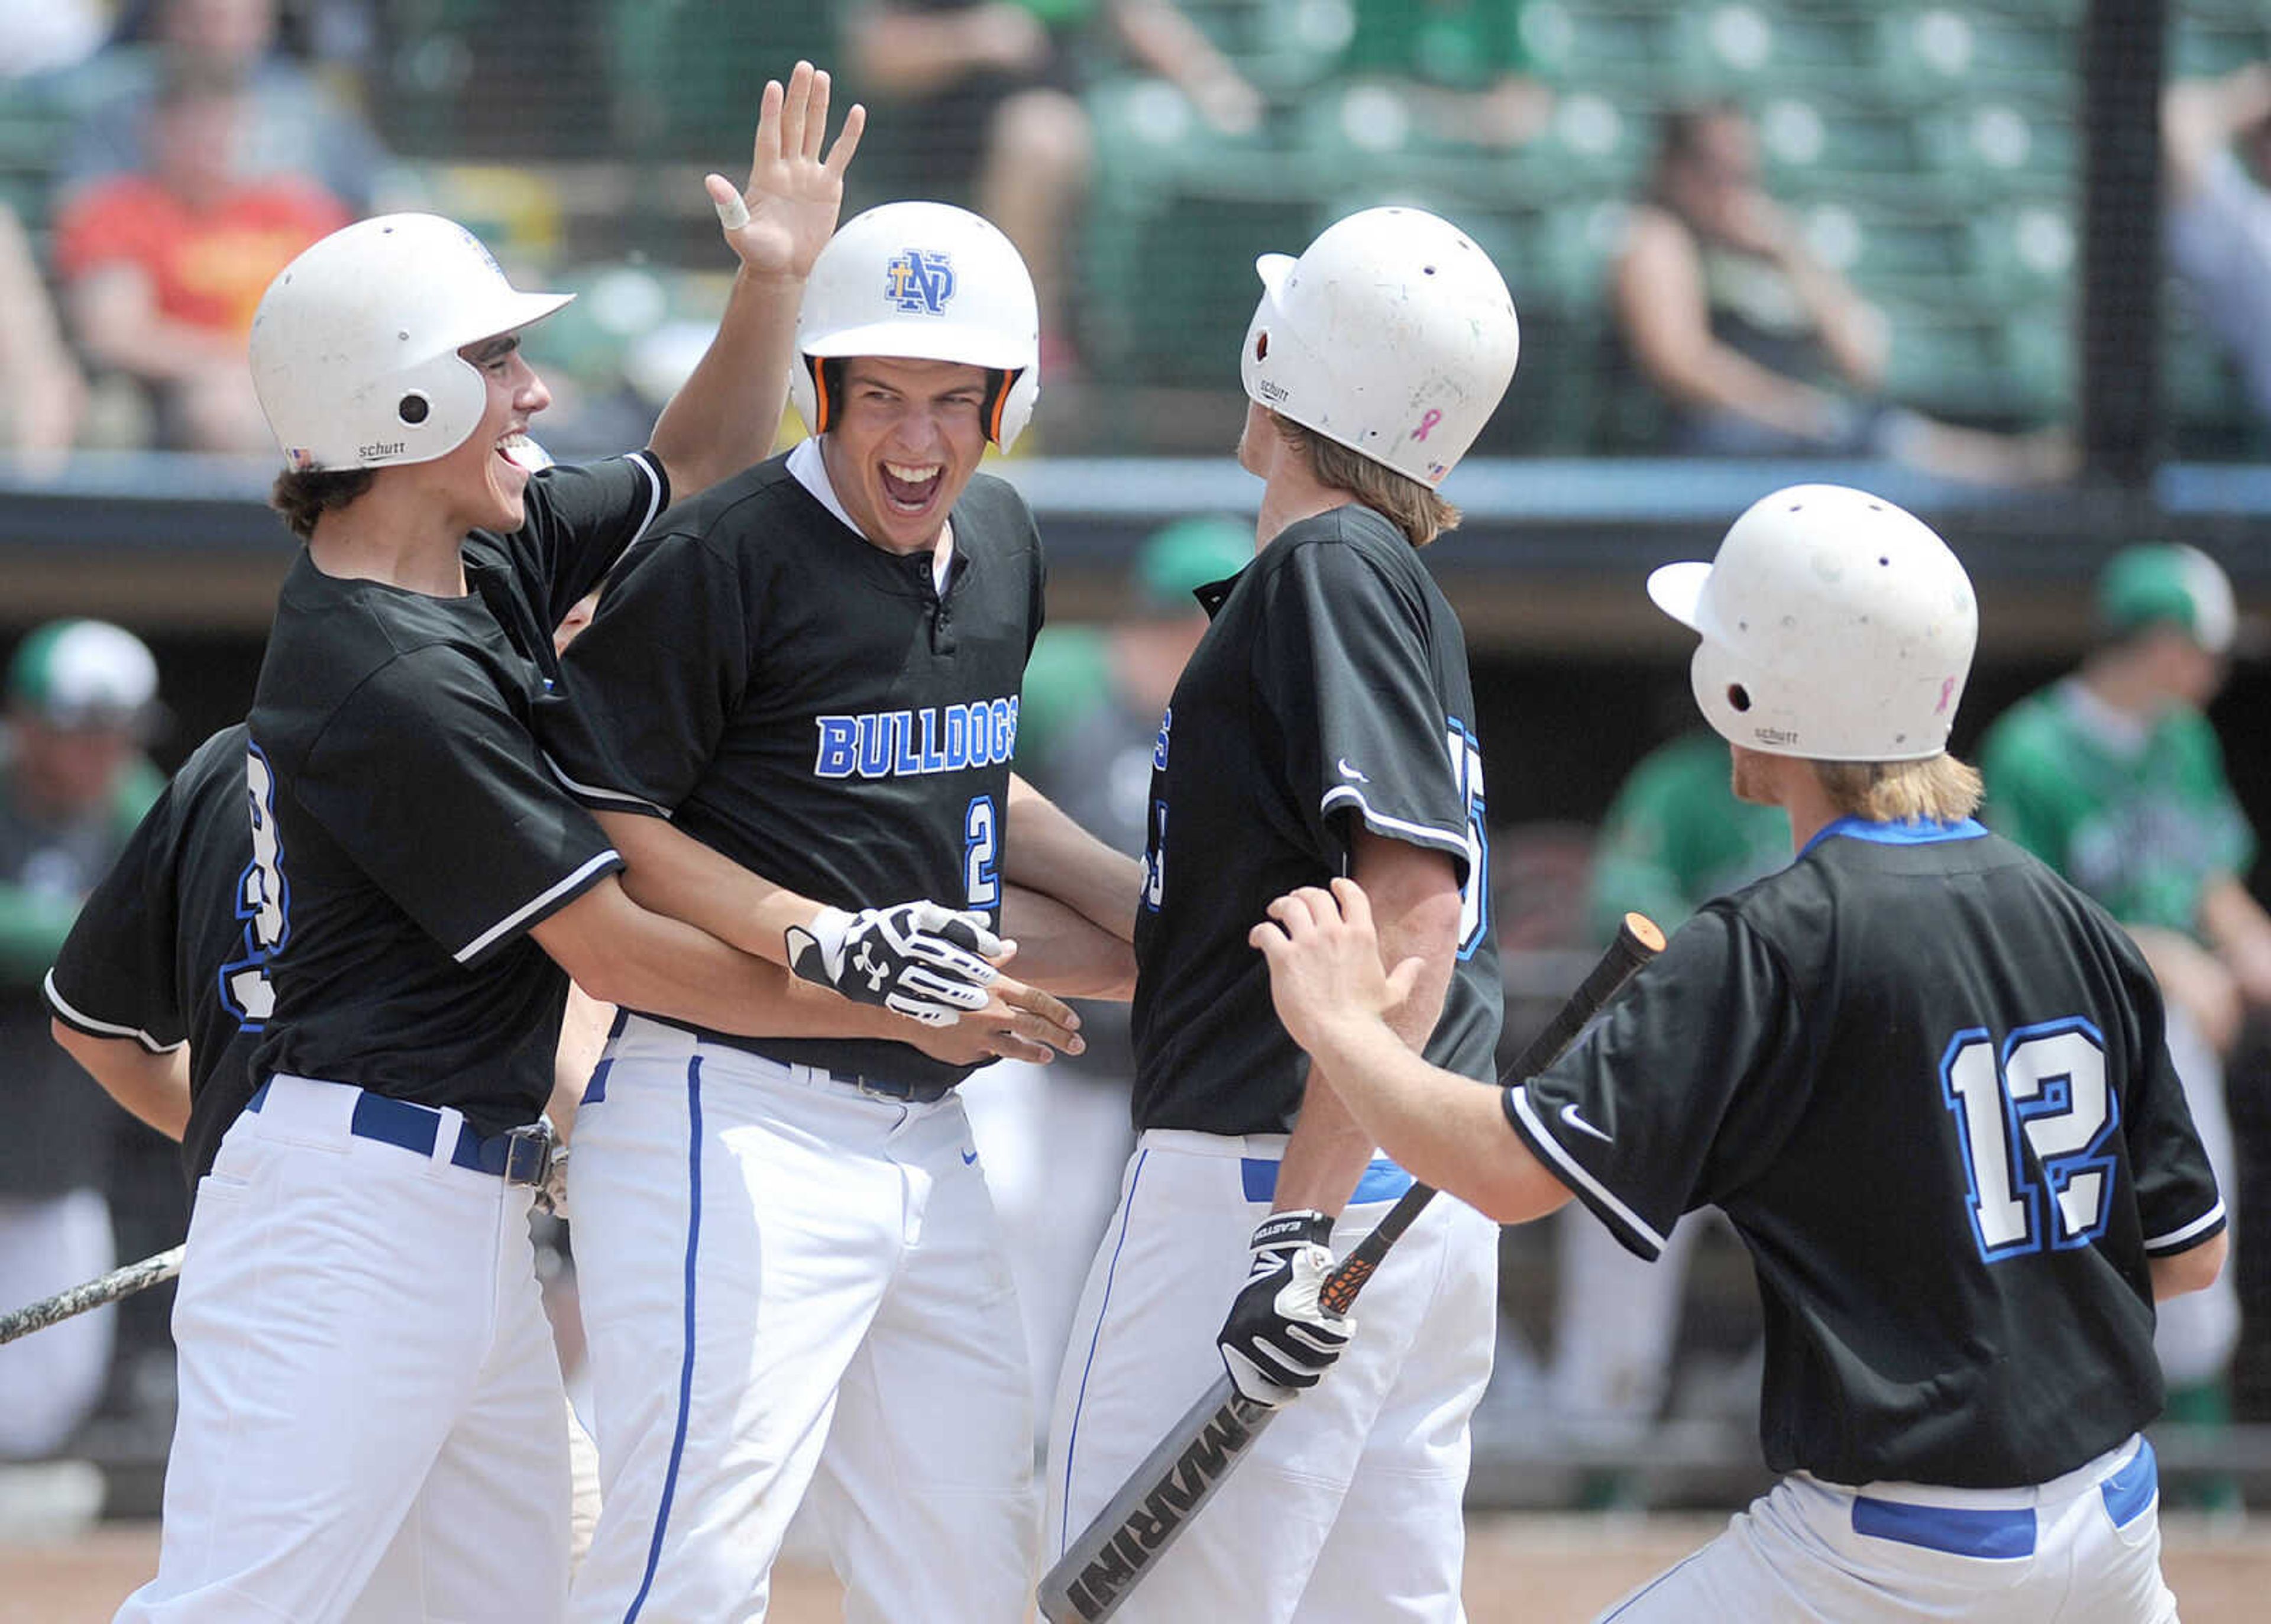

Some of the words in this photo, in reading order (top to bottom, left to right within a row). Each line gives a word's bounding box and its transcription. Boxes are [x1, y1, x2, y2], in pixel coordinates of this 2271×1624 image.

[358, 442, 406, 459] schutt
[964, 795, 1001, 911] 2
[1938, 1015, 2121, 1264] 12
